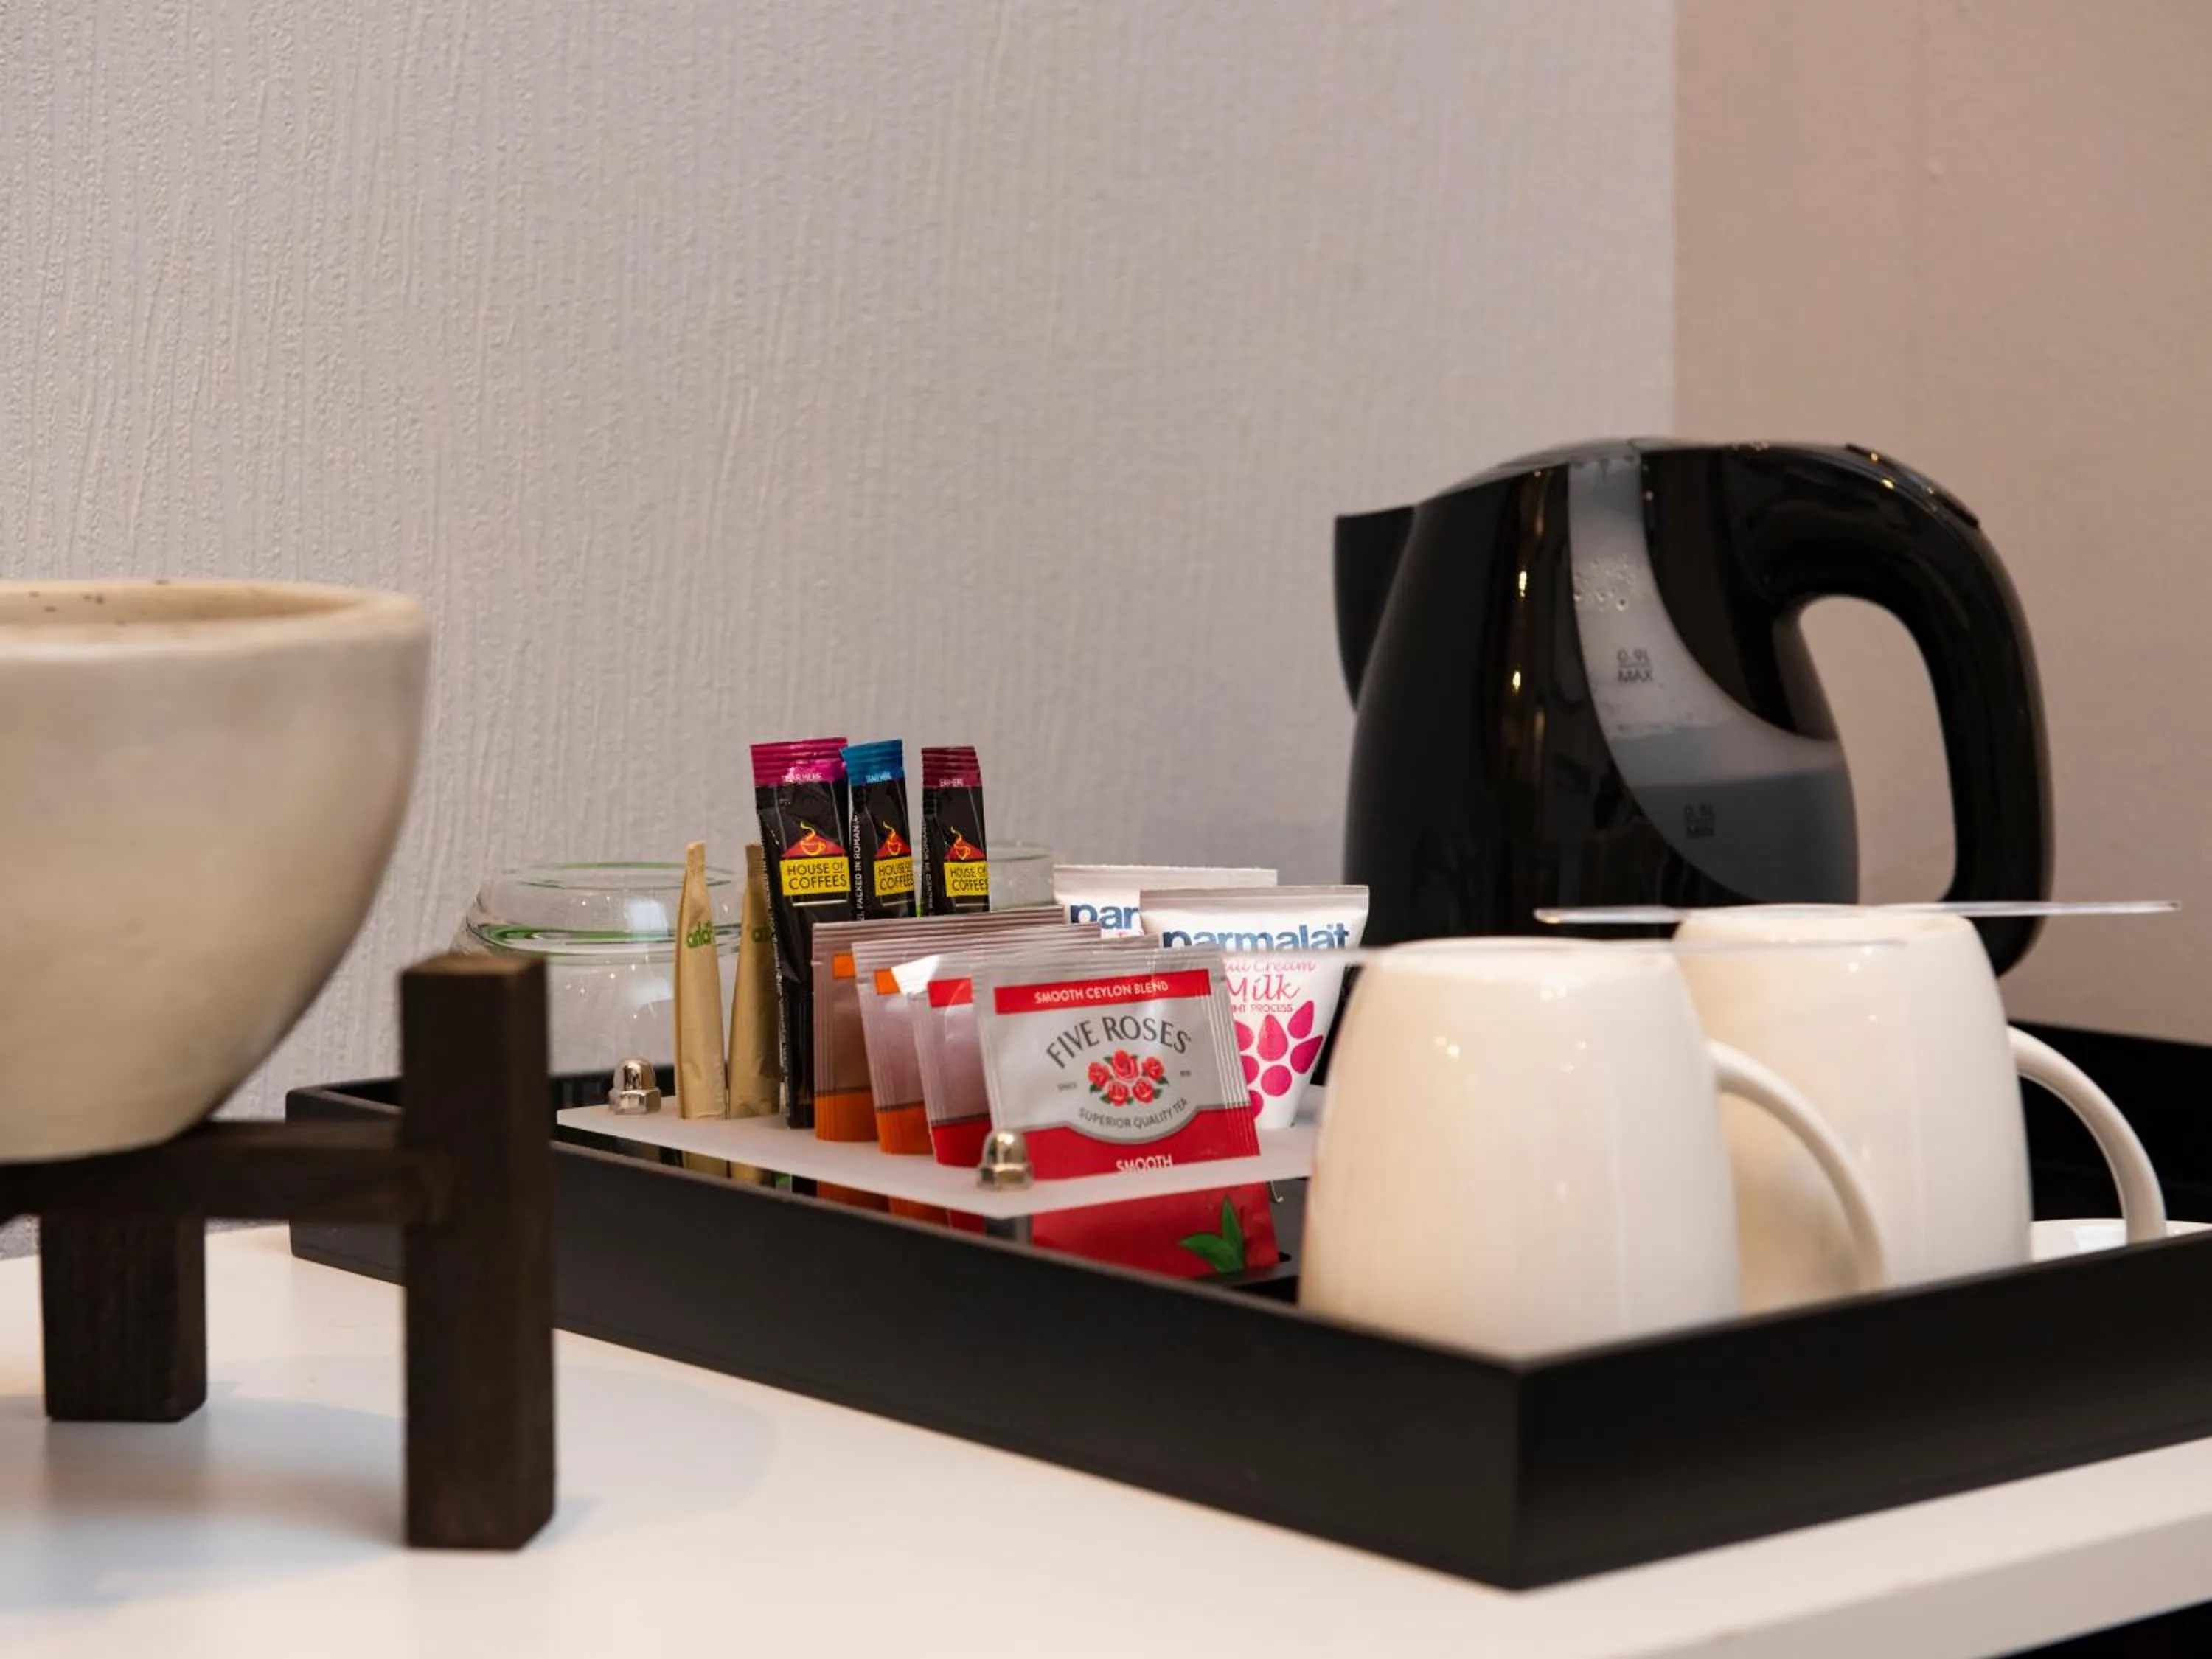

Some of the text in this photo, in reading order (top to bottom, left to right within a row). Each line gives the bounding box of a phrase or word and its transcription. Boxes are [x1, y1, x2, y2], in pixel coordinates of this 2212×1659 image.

[1618, 669, 1653, 684] MAX
[787, 863, 830, 876] HOUSE
[855, 863, 862, 872] IN
[950, 866, 977, 878] HOUSE
[788, 874, 847, 890] COFFEES
[855, 874, 864, 909] PACKED
[1035, 980, 1169, 1004] SMOOTH CEYLON BLEND
[1226, 974, 1301, 1004] Milk
[1251, 1004, 1293, 1012] PROCESS
[1046, 1015, 1189, 1069] FIVE ROSES
[1079, 1097, 1188, 1129] SUPERIOR QUALITY TEA
